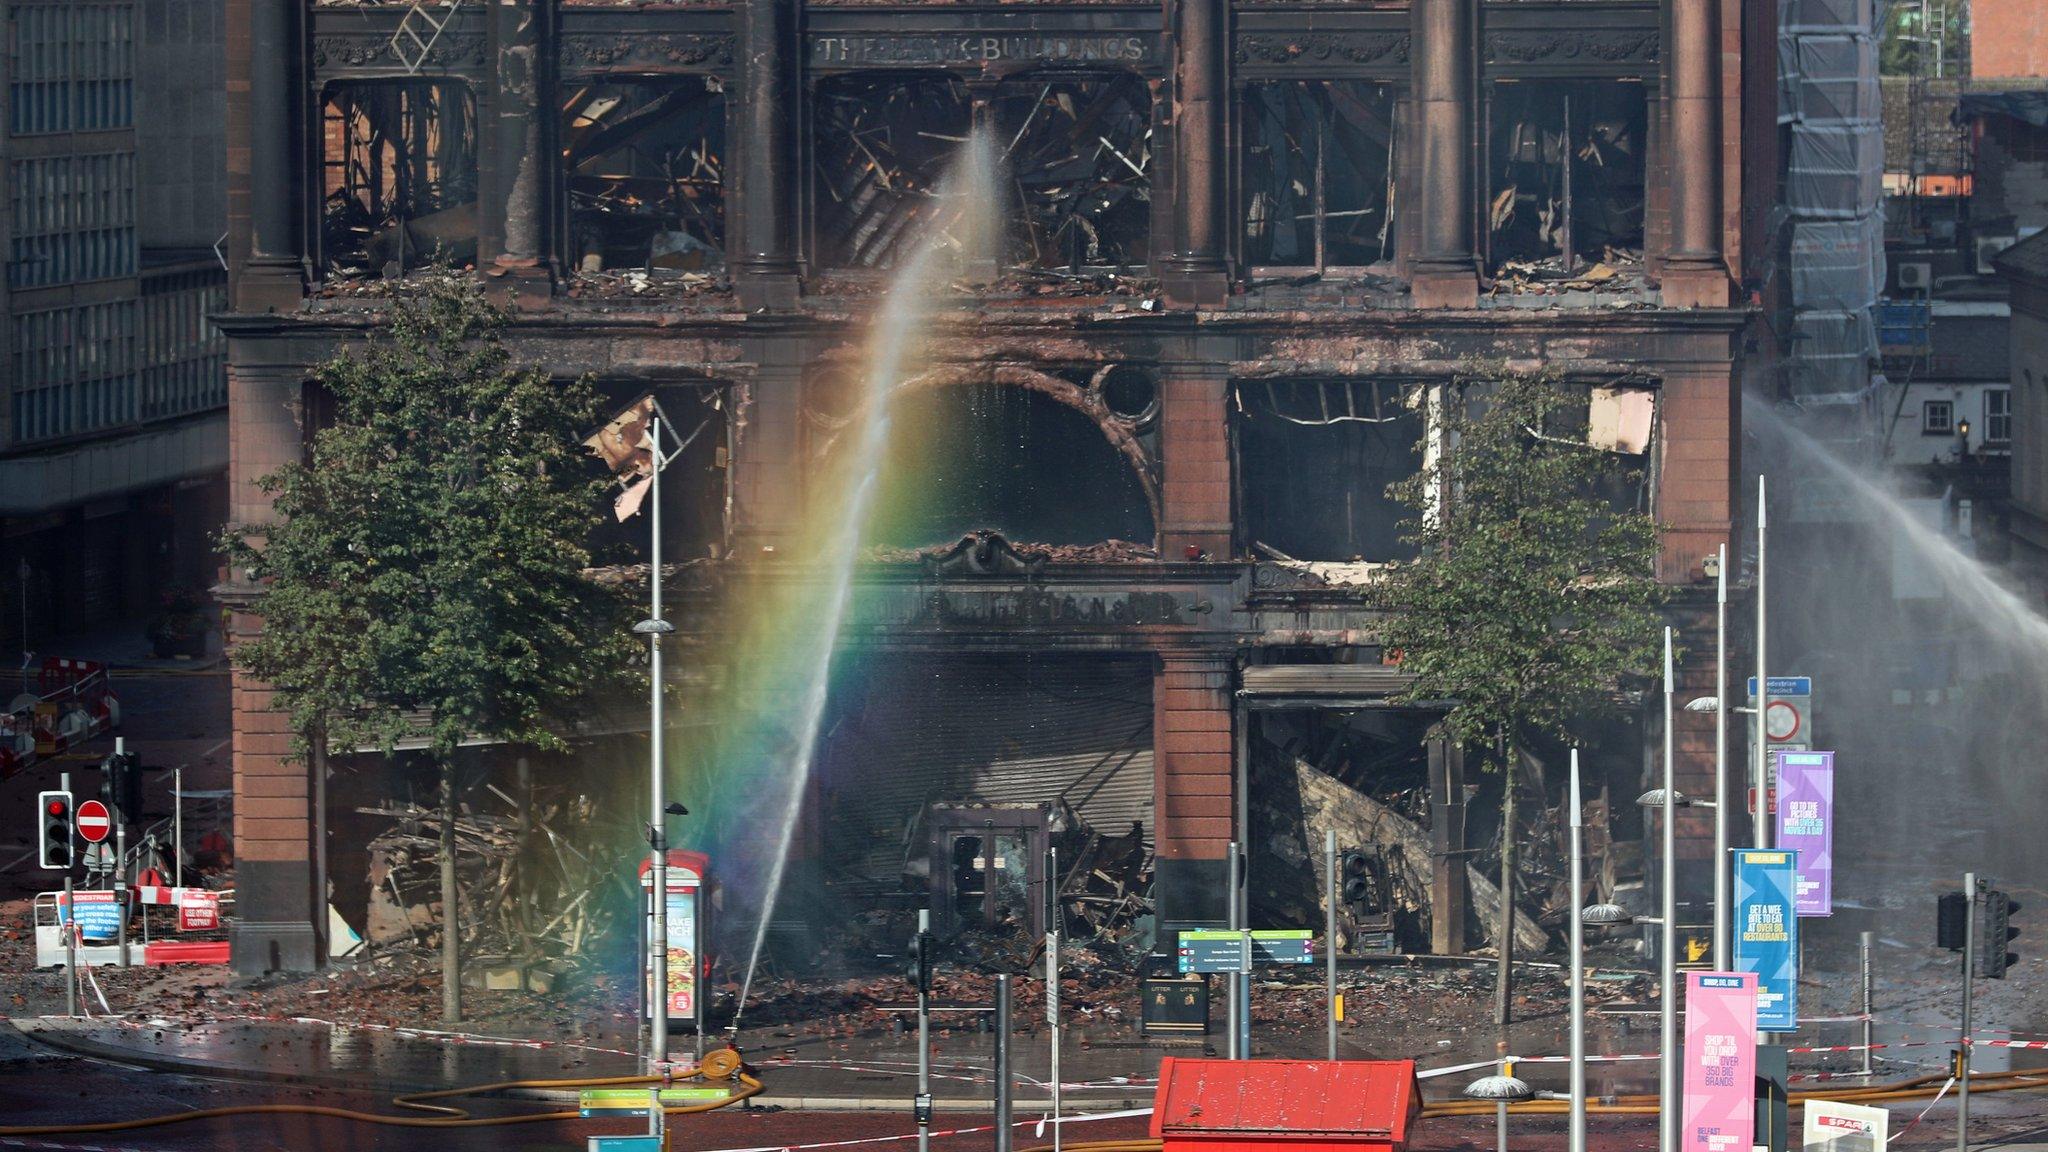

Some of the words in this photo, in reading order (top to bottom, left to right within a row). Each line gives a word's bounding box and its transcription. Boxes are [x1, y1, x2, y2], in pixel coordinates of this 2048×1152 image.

[1799, 801, 1807, 810] TO
[1784, 818, 1799, 826] WITH
[1750, 904, 1762, 914] GET
[1762, 904, 1768, 914] A
[1768, 904, 1782, 914] WEE
[1748, 913, 1762, 923] BITE
[1763, 914, 1770, 923] TO
[1772, 914, 1783, 923] EAT
[1747, 923, 1756, 932] AT
[1757, 923, 1773, 932] OVER
[1743, 932, 1788, 941] RESTAURANTS
[1704, 1034, 1723, 1046] SHOP
[1703, 1045, 1719, 1056] YOU
[1719, 1045, 1738, 1056] DROP
[1701, 1055, 1719, 1067] WITH
[1720, 1056, 1739, 1067] OVER
[1705, 1066, 1720, 1076] 350
[1721, 1067, 1734, 1077] BIG
[1705, 1076, 1734, 1087] BRANDS
[1828, 1117, 1862, 1130] SPAR
[1697, 1127, 1721, 1135] BELFAST
